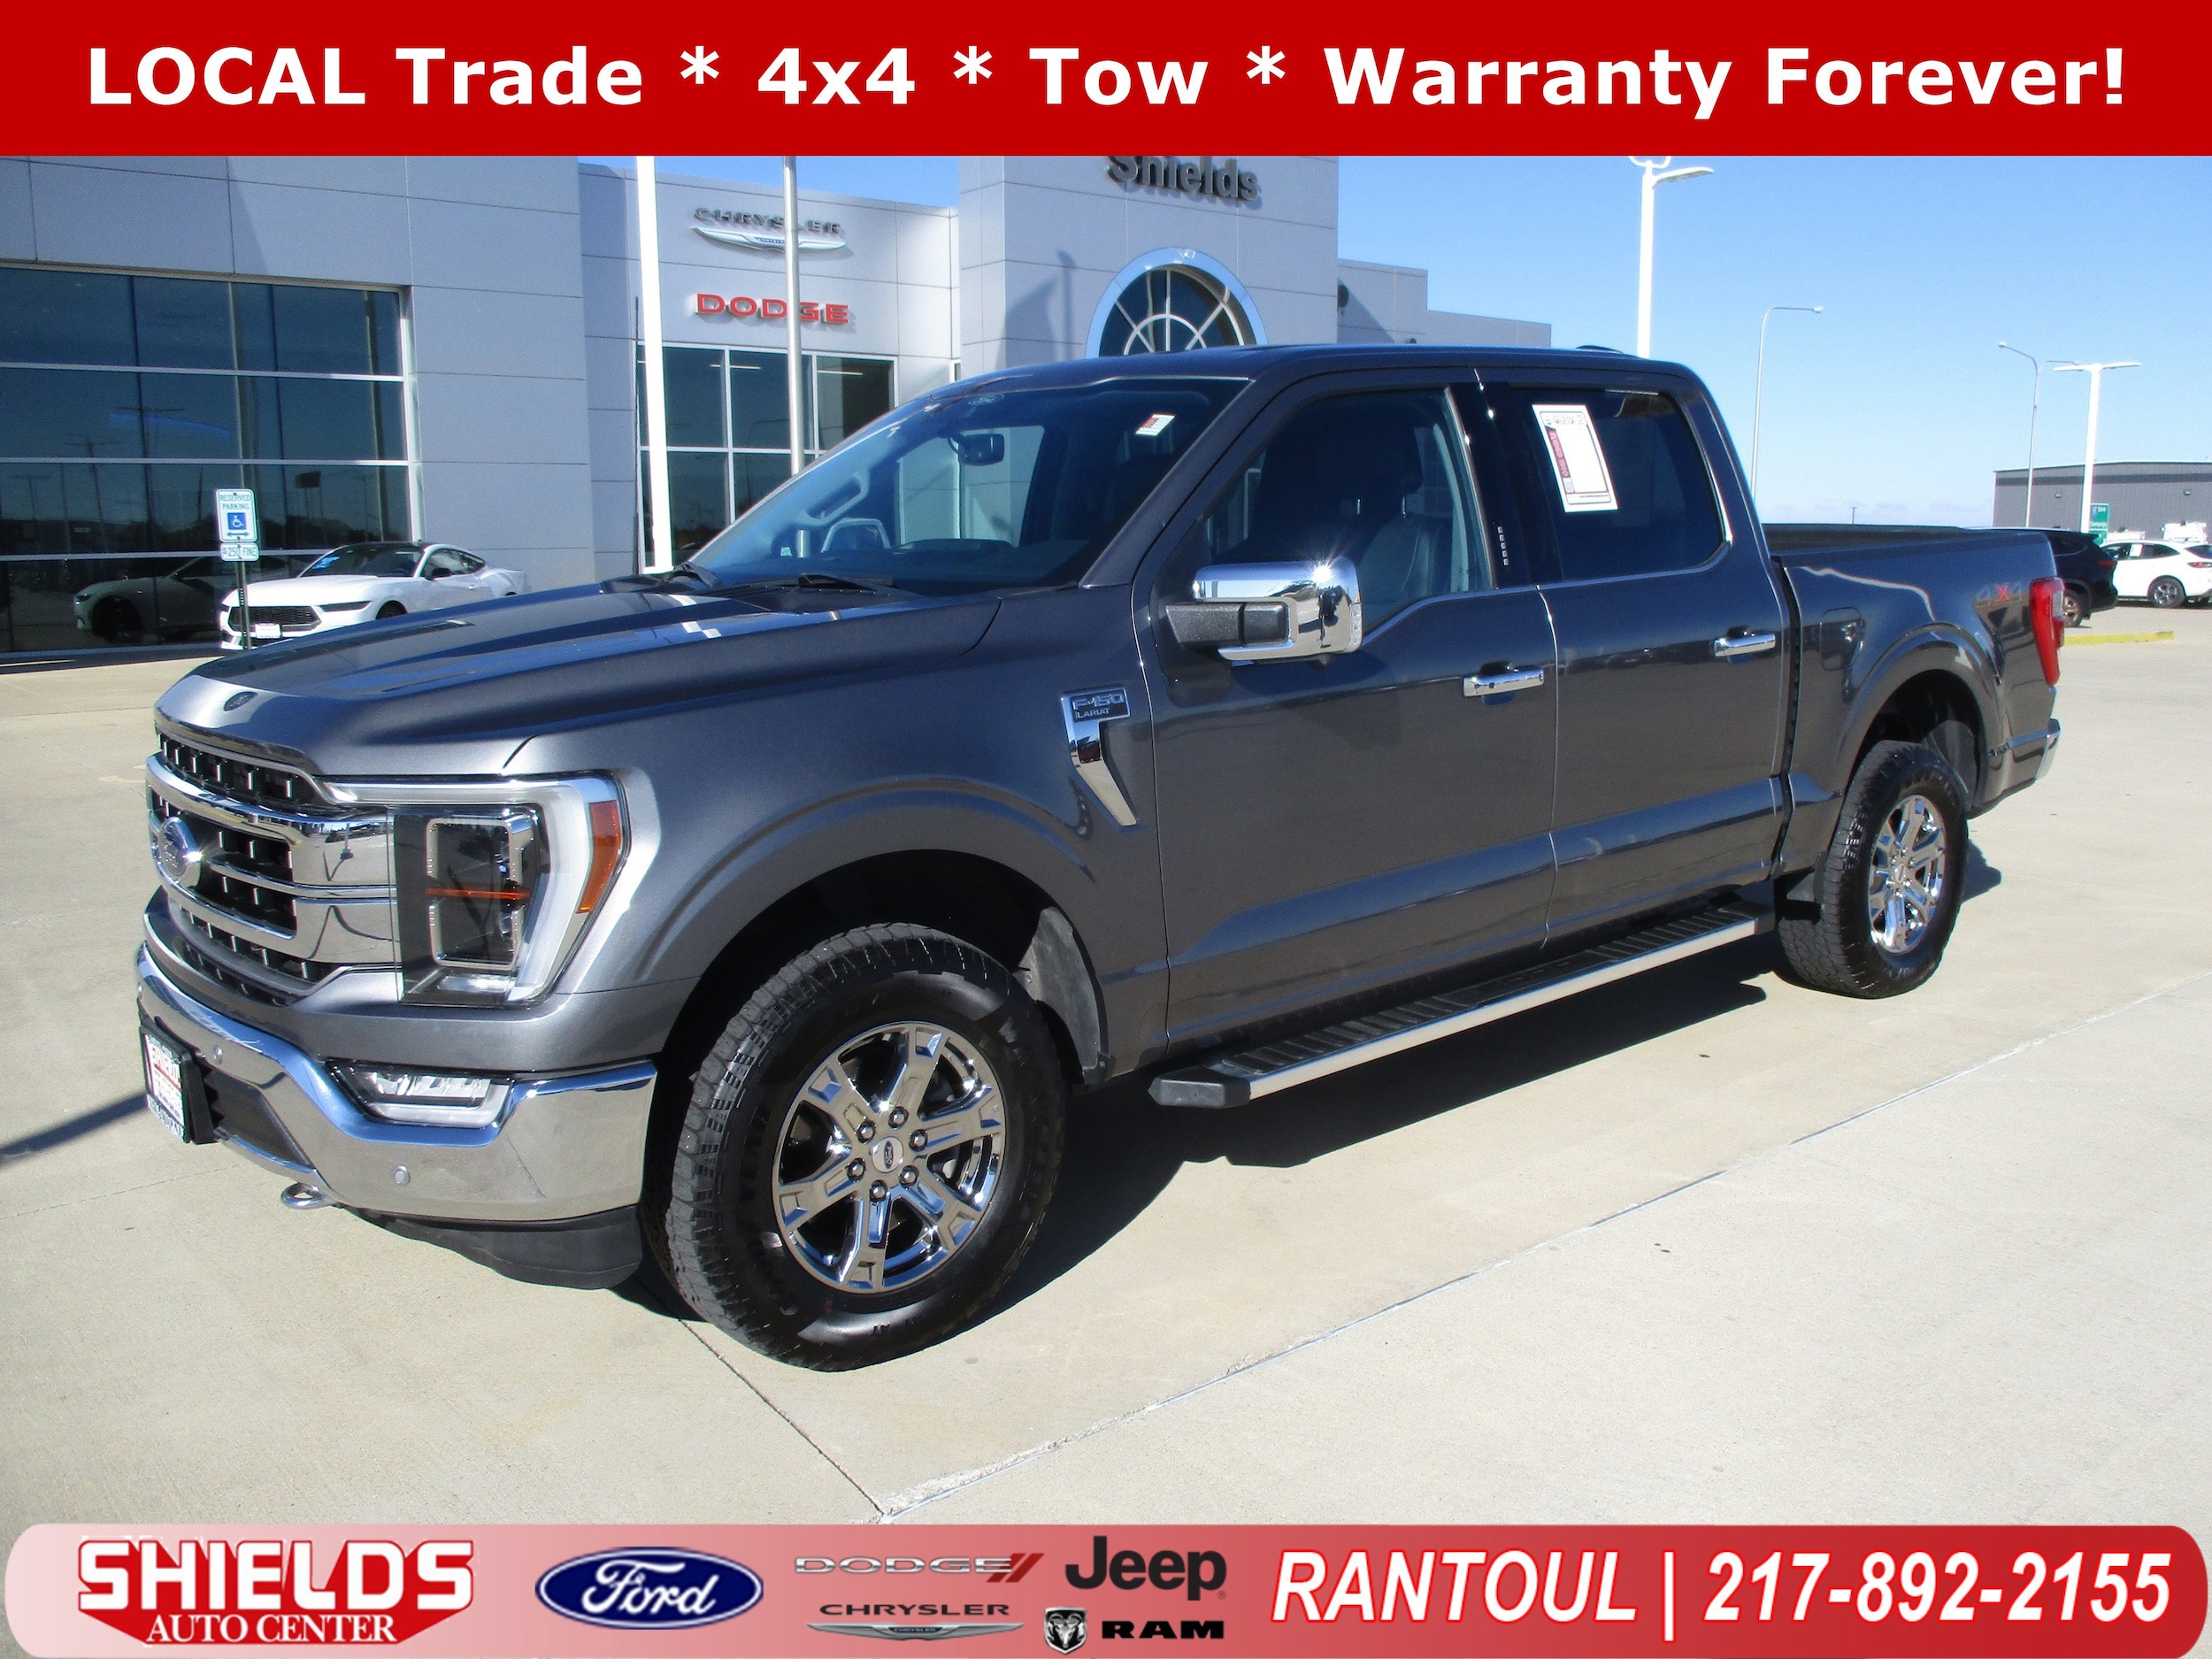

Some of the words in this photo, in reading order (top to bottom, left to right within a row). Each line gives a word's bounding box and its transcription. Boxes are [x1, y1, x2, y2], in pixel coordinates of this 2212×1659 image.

[1107, 156, 1258, 201] Shields
[694, 207, 841, 234] CHRYSER
[697, 293, 849, 324] DODGE
[242, 547, 257, 557] FINE
[1072, 693, 1125, 710] F-150
[1076, 708, 1110, 719] LARIAT
